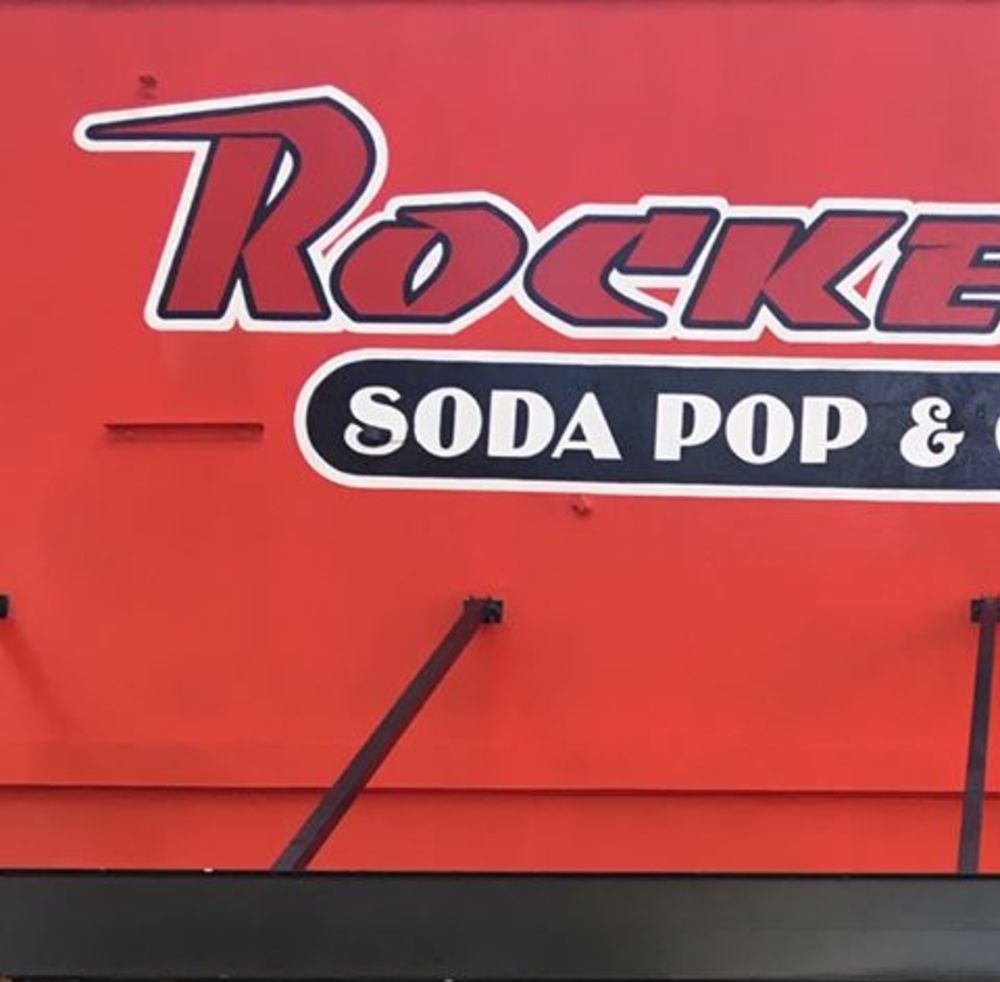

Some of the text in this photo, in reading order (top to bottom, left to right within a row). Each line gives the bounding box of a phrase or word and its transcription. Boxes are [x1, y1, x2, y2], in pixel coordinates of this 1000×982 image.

[344, 387, 622, 460] SODA
[654, 393, 868, 466] POP
[899, 396, 965, 468] &
